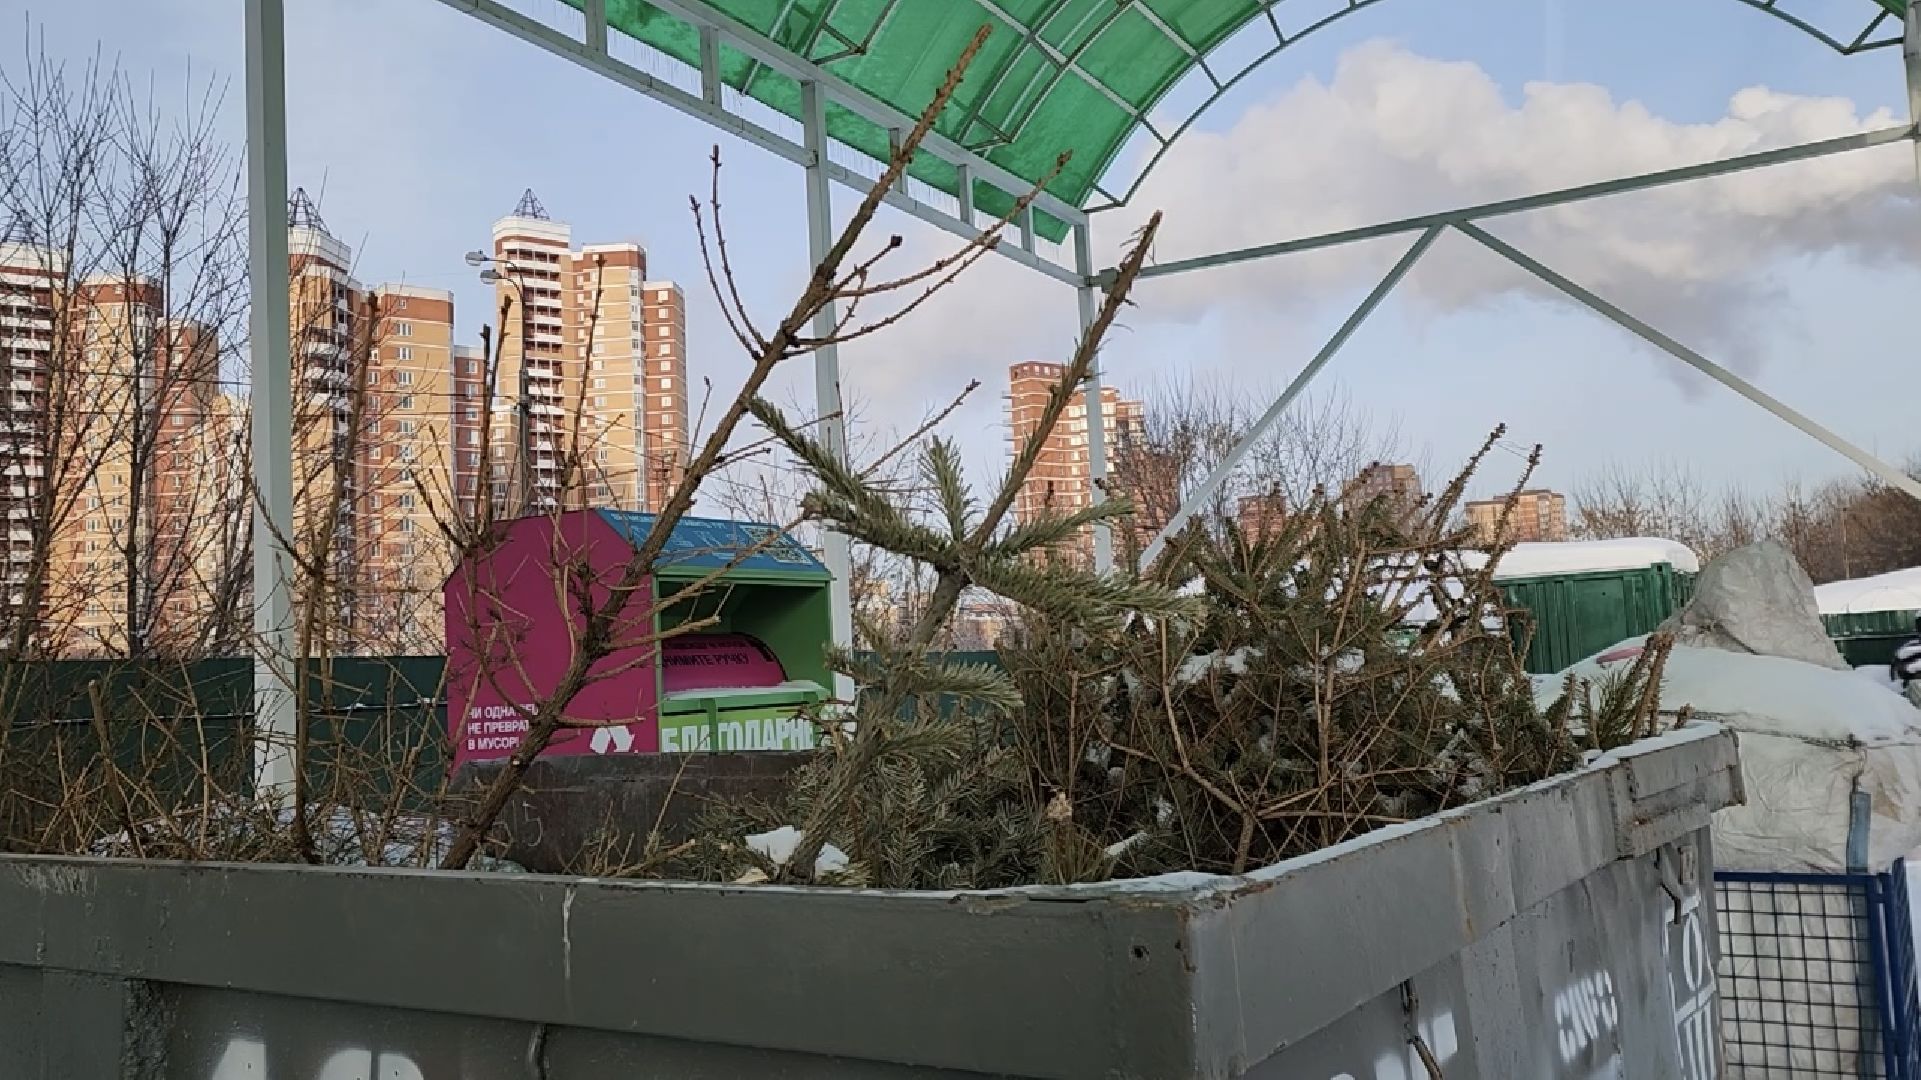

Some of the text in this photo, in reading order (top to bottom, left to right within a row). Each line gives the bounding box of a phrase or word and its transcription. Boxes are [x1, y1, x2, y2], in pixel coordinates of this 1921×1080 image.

[484, 705, 517, 719] ОДНА
[467, 722, 482, 735] НЕ
[467, 738, 476, 750] В
